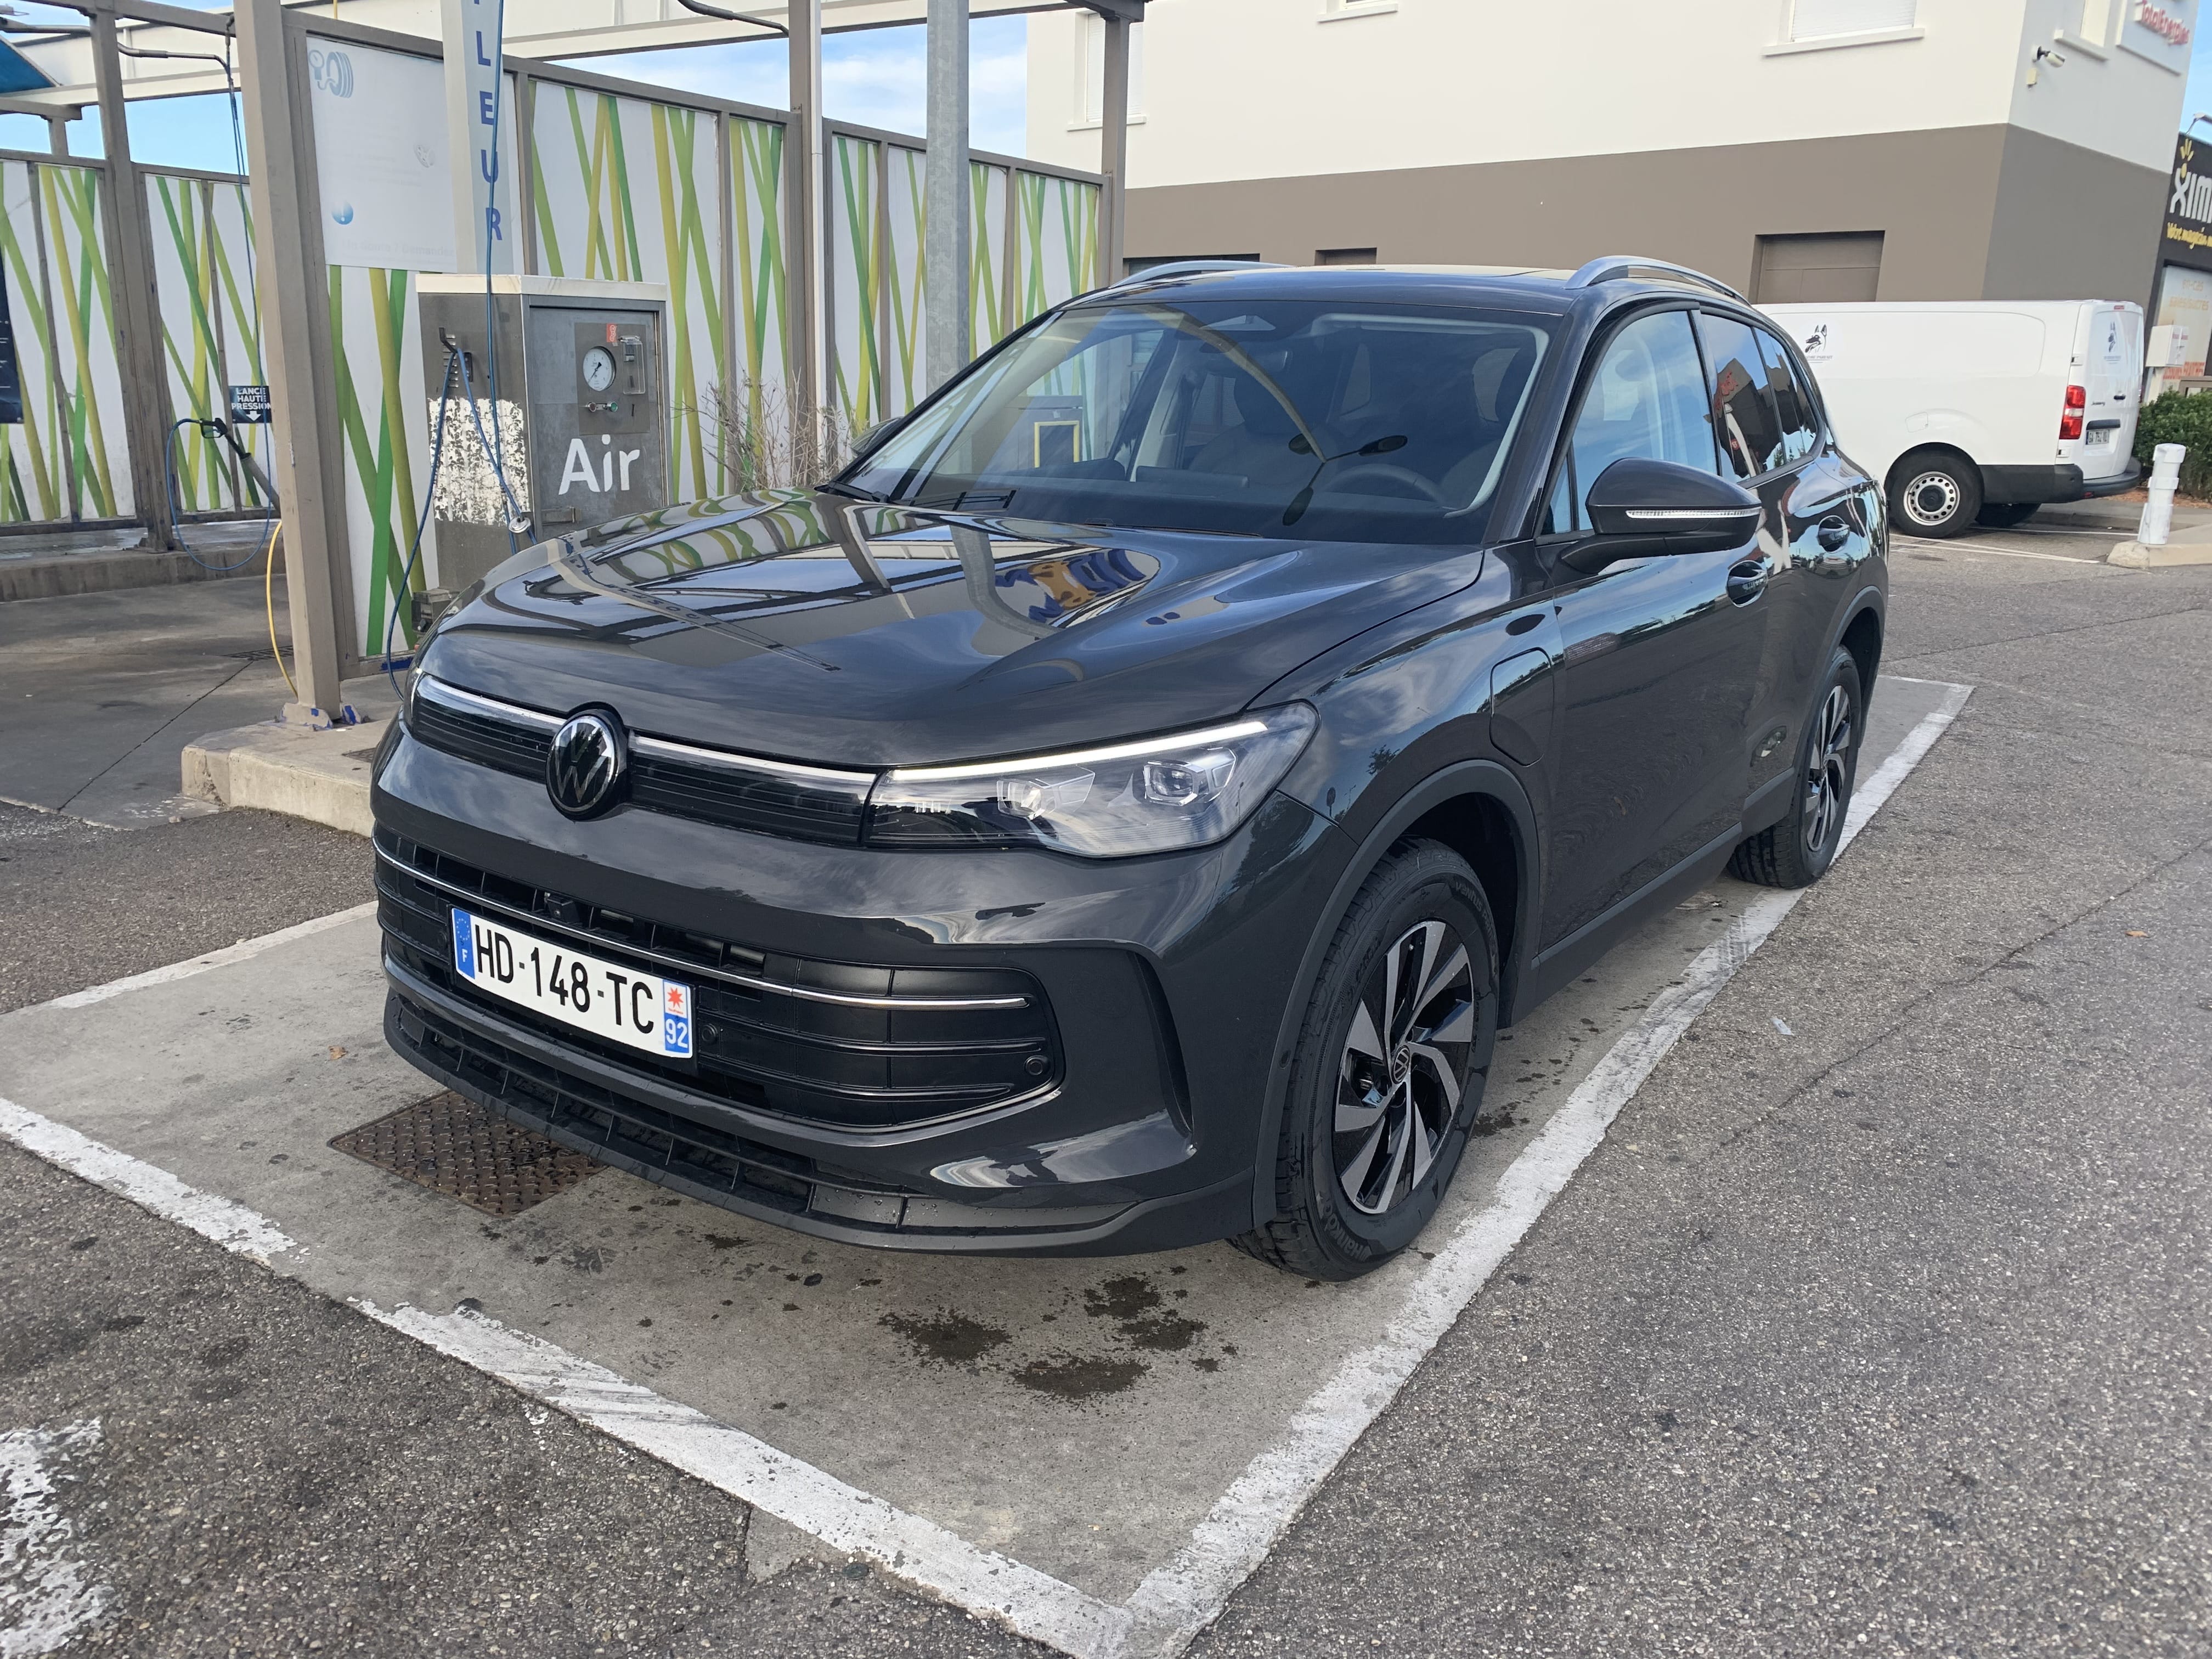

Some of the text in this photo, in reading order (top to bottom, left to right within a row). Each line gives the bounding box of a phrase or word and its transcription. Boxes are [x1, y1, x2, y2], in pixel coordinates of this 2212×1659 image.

[474, 0, 503, 240] LEUR
[558, 434, 640, 495] Air
[461, 948, 468, 962] F
[475, 924, 654, 1034] HD-148-TC
[665, 1018, 688, 1048] 92
